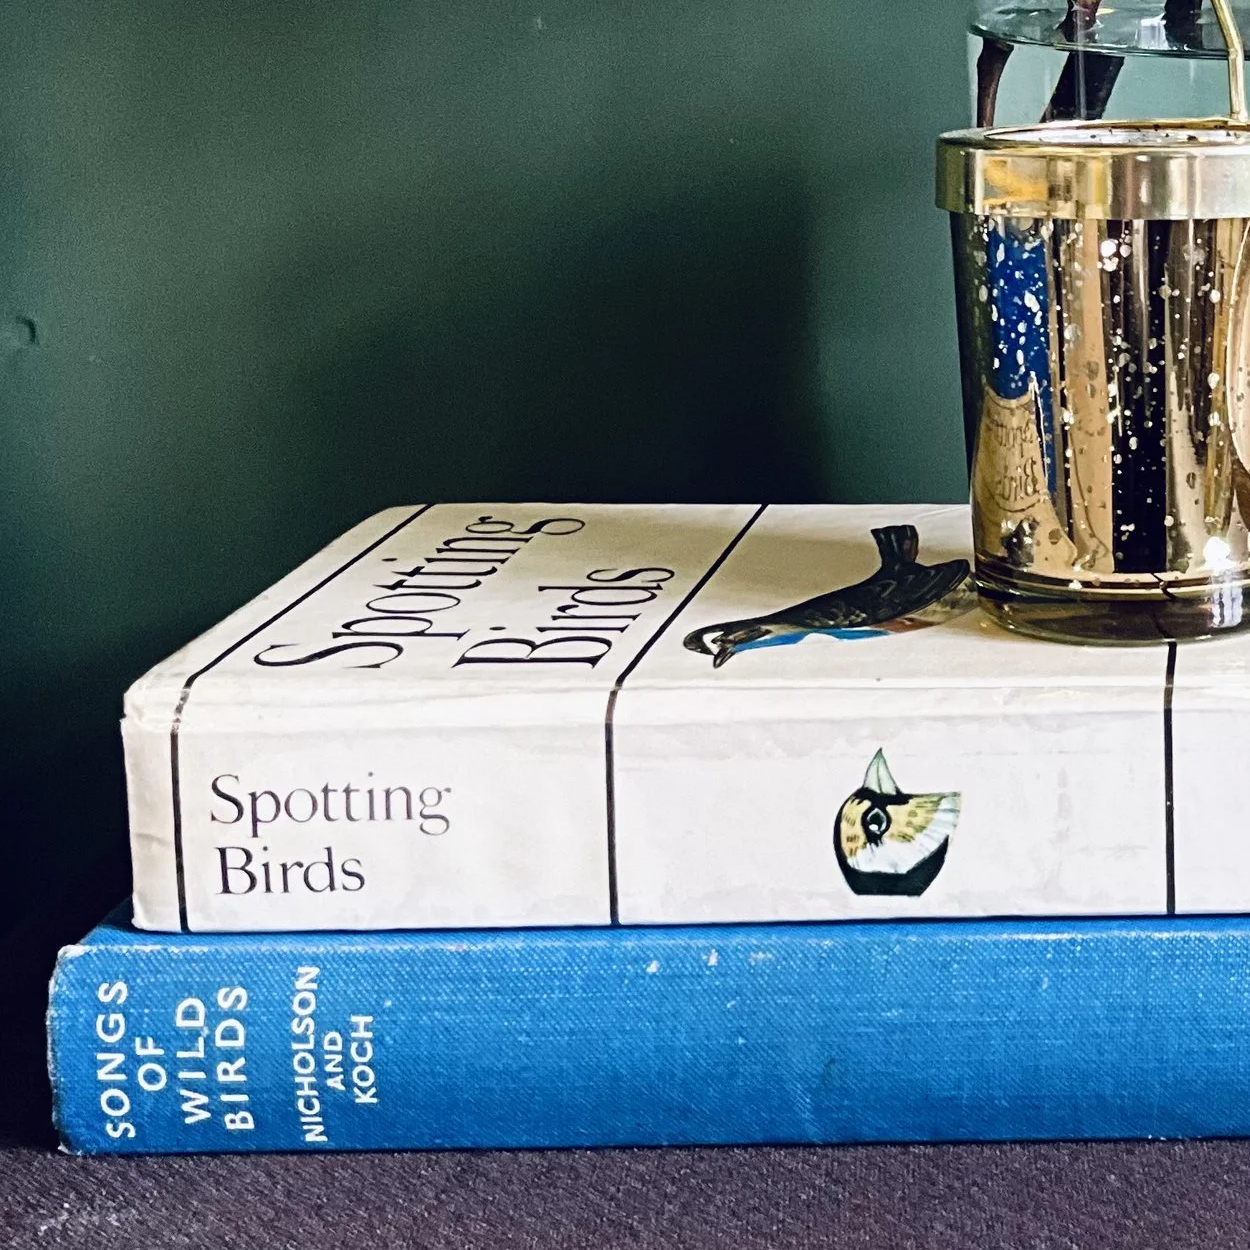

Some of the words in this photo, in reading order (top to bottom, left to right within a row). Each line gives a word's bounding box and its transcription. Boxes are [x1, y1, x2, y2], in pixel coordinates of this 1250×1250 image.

[253, 516, 586, 668] Spotting
[451, 566, 676, 669] Birds
[210, 771, 453, 838] Spotting
[214, 845, 367, 895] Birds
[96, 980, 136, 1138] SONGS
[134, 1036, 168, 1092] OF
[175, 997, 212, 1124] WILD
[214, 985, 255, 1130] BIRDS
[291, 966, 328, 1142] NICHOLSON
[322, 1030, 346, 1091] AND
[350, 1015, 378, 1104] KOCH
